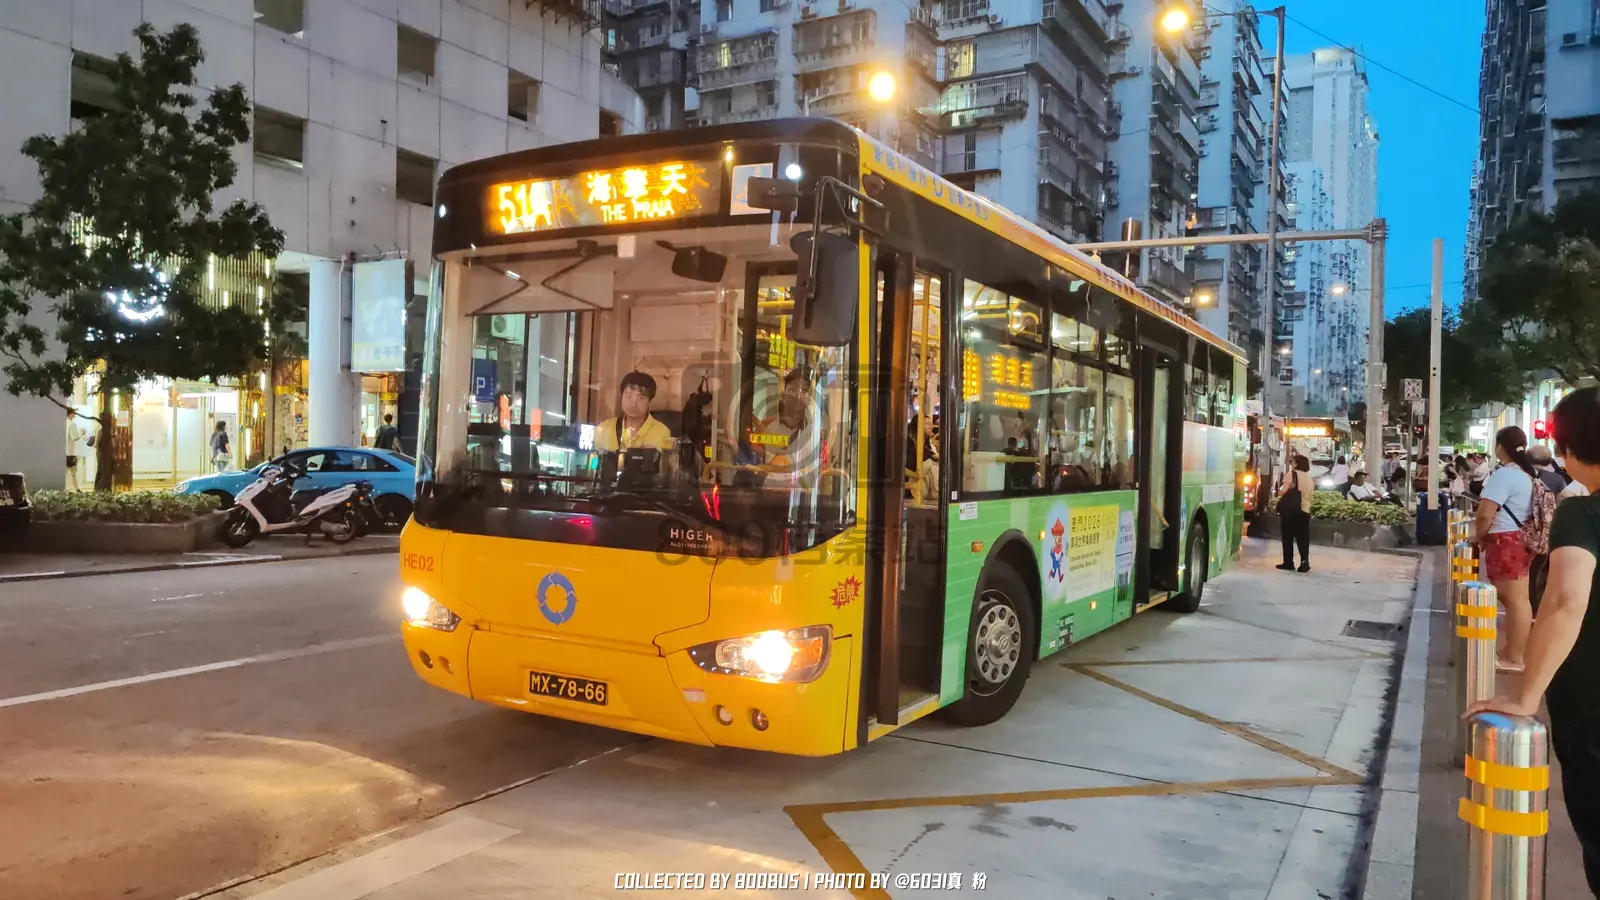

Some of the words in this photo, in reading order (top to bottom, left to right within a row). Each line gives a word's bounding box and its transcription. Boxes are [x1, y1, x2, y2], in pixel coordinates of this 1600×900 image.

[498, 181, 552, 234] 51A
[600, 204, 627, 223] THE
[631, 198, 675, 220] PRAIA
[670, 528, 714, 542] HIGER
[403, 552, 434, 573] HE02
[530, 673, 606, 702] MX-78-66
